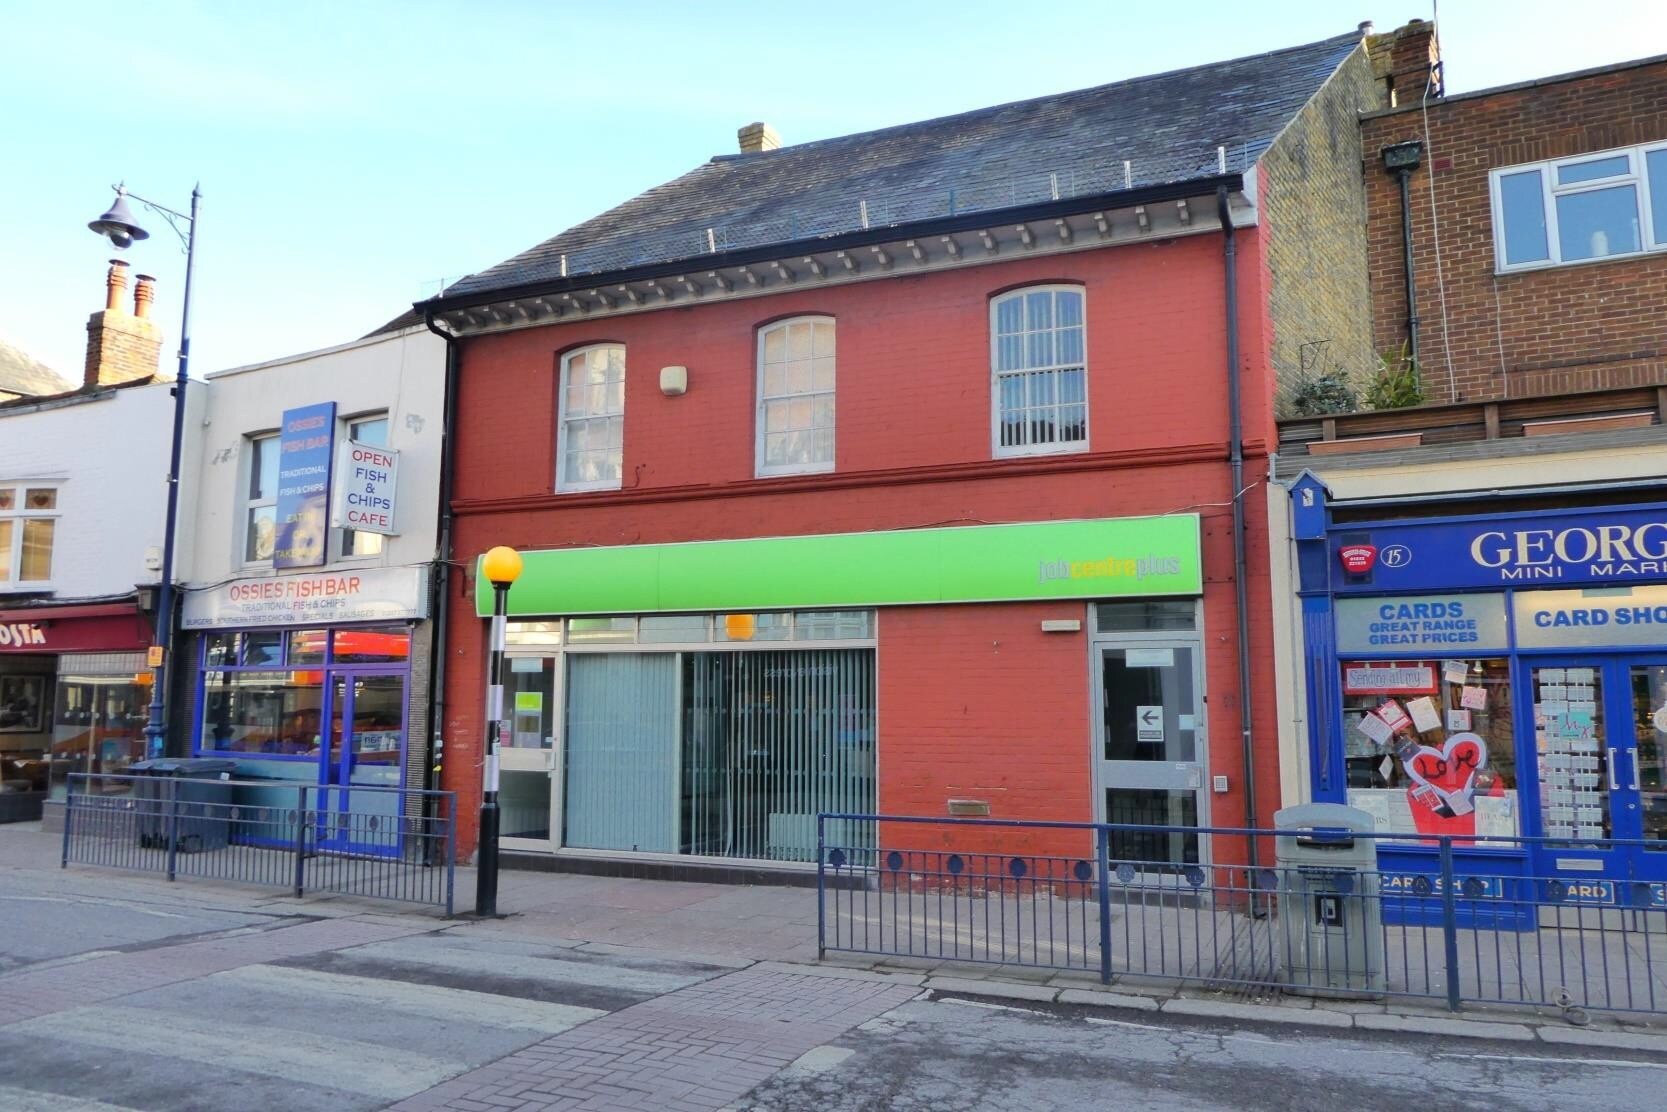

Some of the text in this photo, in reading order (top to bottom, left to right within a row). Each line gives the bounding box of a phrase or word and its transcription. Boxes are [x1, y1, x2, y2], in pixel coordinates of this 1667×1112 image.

[282, 439, 305, 454] FISH
[352, 449, 393, 468] OPEN
[281, 465, 327, 479] TRADITIONAL
[356, 467, 388, 484] FISH
[280, 487, 295, 497] FISH
[302, 482, 325, 494] CHIPS
[365, 482, 376, 494] &
[348, 492, 391, 510] CHIPS
[348, 510, 389, 527] CAFE
[1470, 523, 1667, 567] GEORG
[1387, 549, 1402, 565] 15
[1501, 566, 1562, 580] MINI
[230, 576, 360, 601] OSSIES FISH BAR
[242, 601, 291, 613] TRADITIONAL
[293, 600, 311, 610] FISH
[320, 598, 345, 609] CHIPS
[1379, 601, 1464, 620] CARDS
[1534, 606, 1667, 628] CARD SHO
[1369, 619, 1477, 633] GREAT RANGE
[1369, 631, 1478, 645] GREAT PRICES
[1560, 884, 1608, 898] ARD
